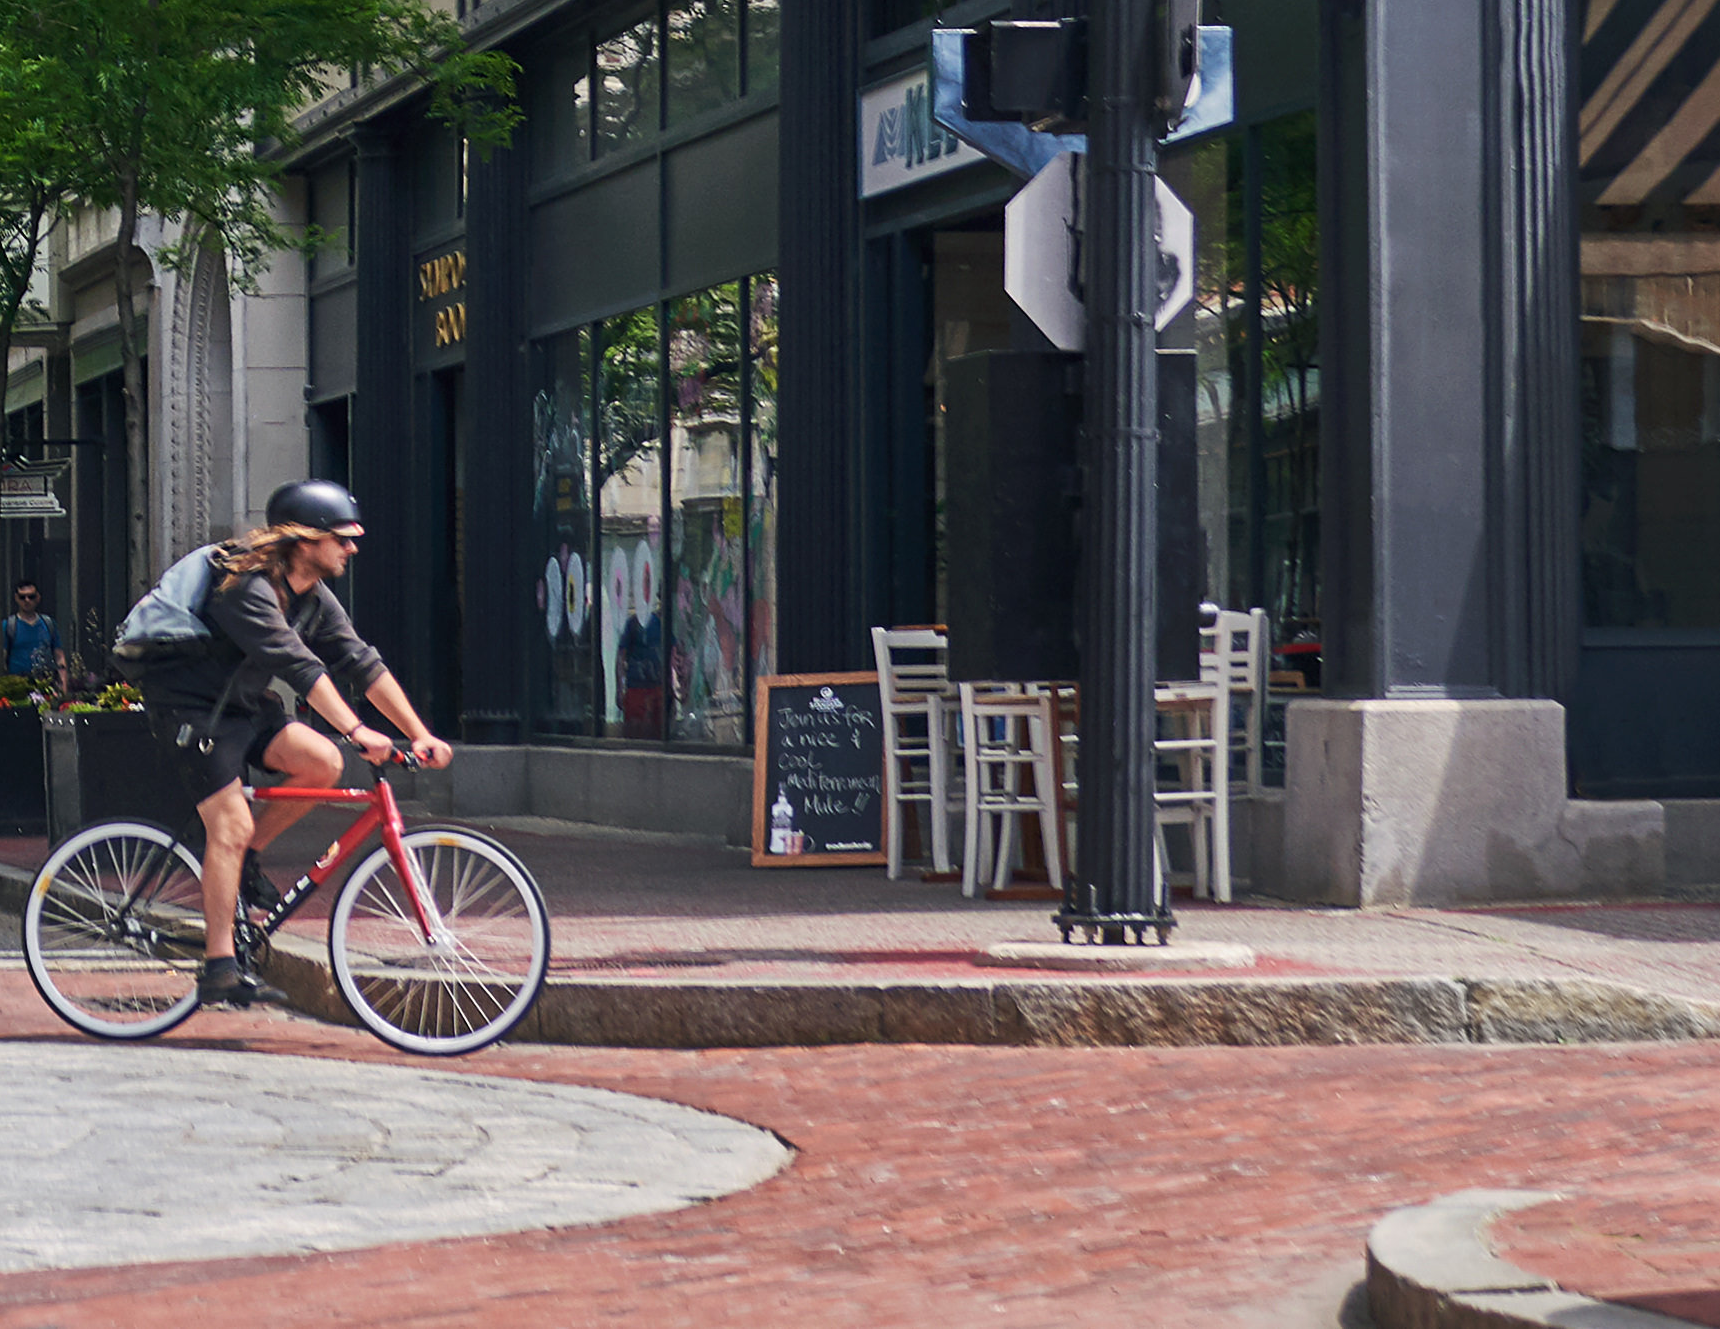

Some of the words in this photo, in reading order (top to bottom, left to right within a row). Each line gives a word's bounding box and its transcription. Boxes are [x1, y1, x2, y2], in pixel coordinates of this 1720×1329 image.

[436, 302, 466, 348] BOO
[781, 735, 795, 748] a
[799, 731, 840, 748] nice
[804, 794, 849, 816] Mule
